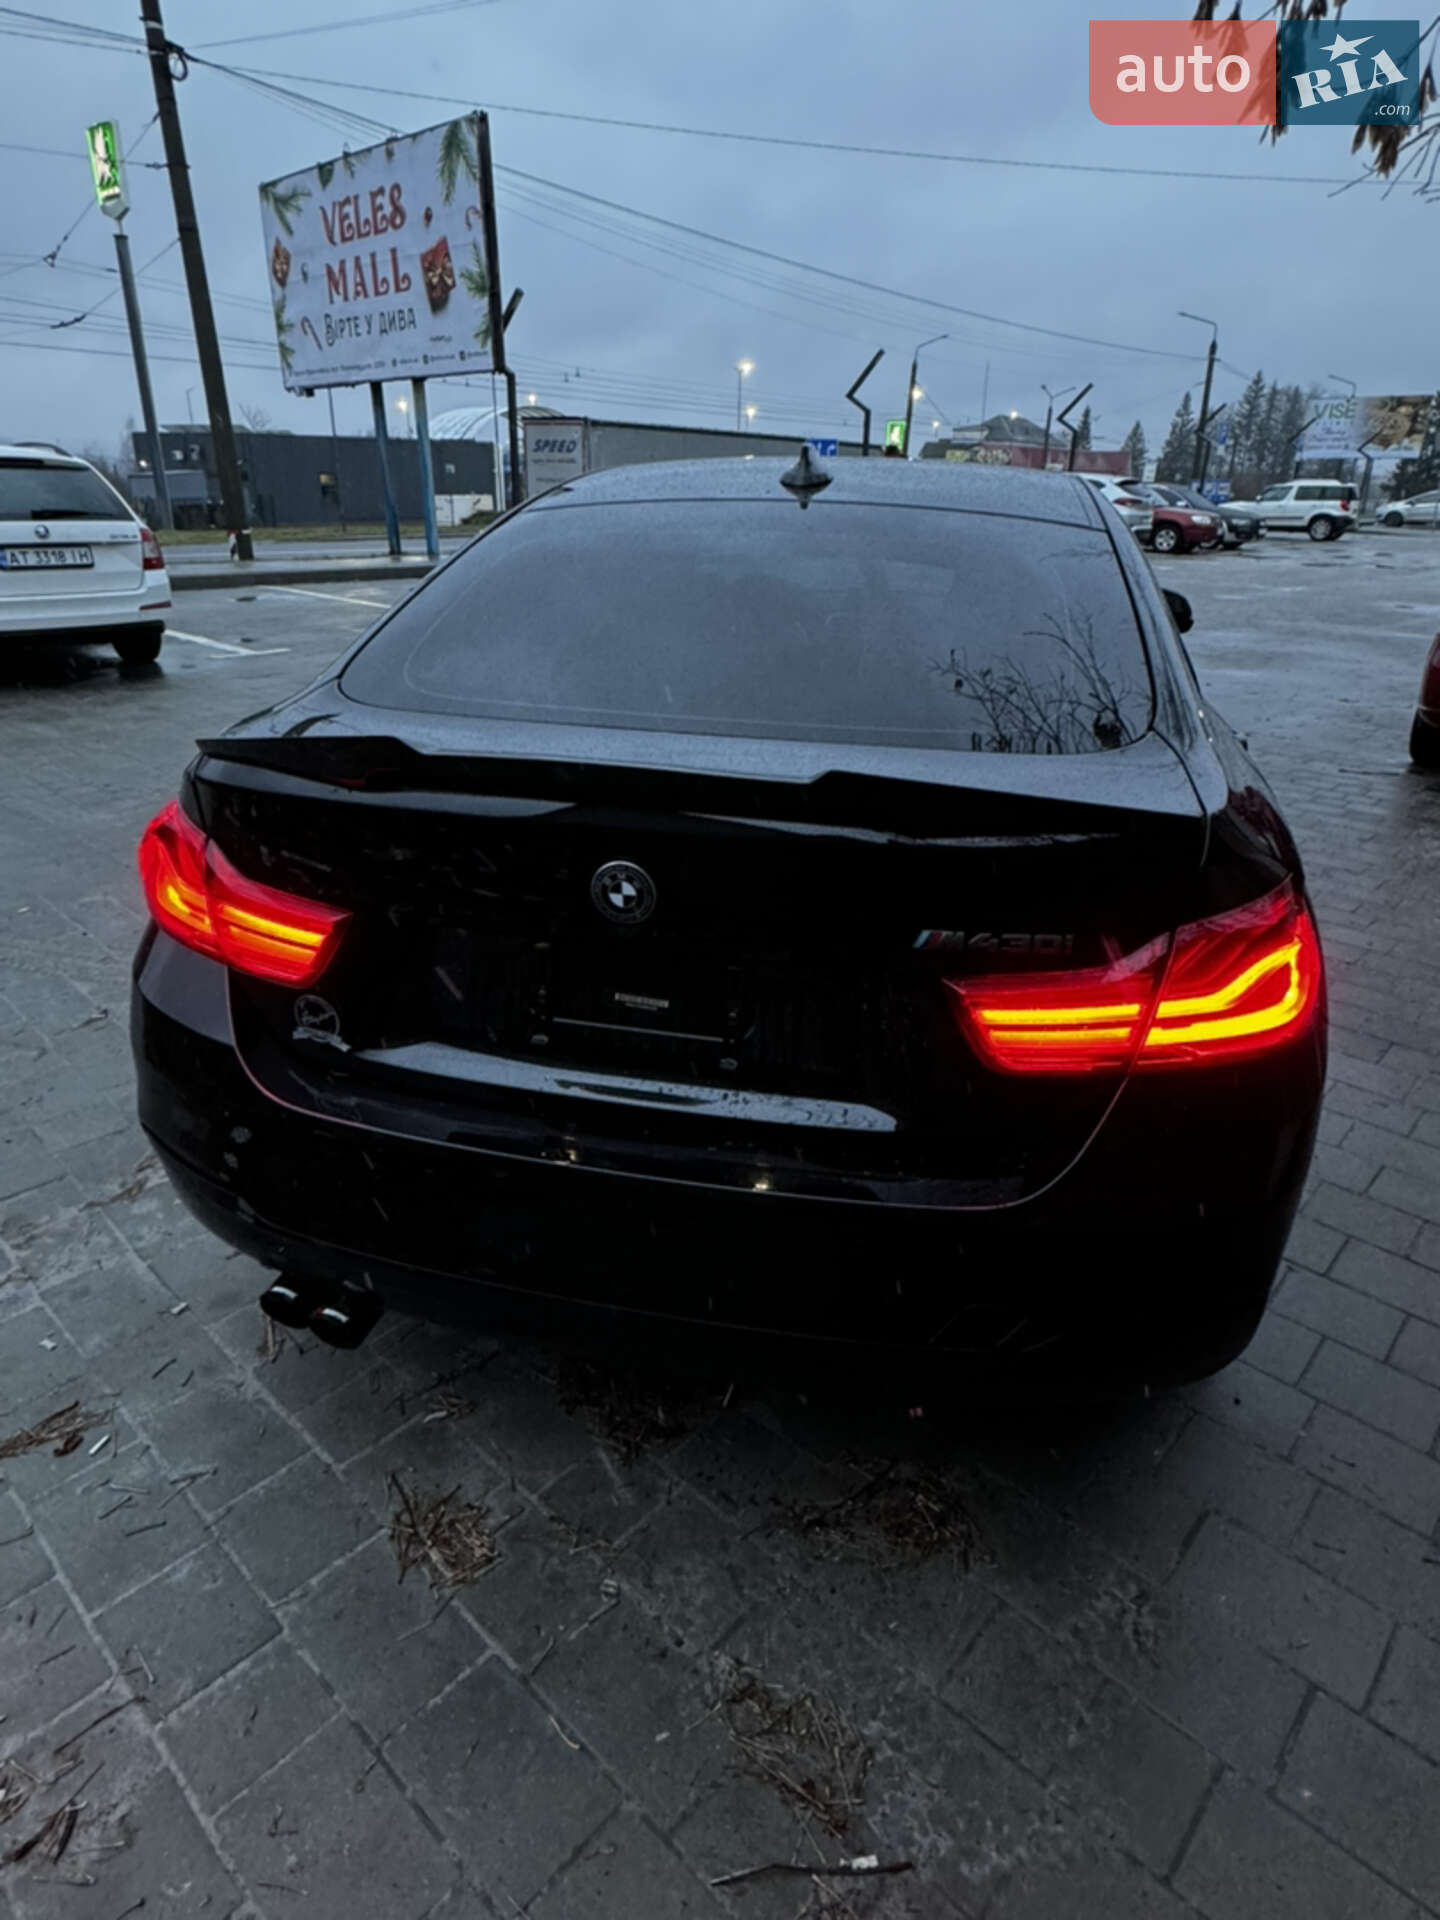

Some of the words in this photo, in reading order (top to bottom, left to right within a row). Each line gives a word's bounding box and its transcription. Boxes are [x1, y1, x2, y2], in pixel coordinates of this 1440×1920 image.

[325, 247, 412, 305] MALL
[379, 307, 417, 337] ДИВА
[532, 438, 577, 453] SPEED
[10, 550, 28, 565] AT
